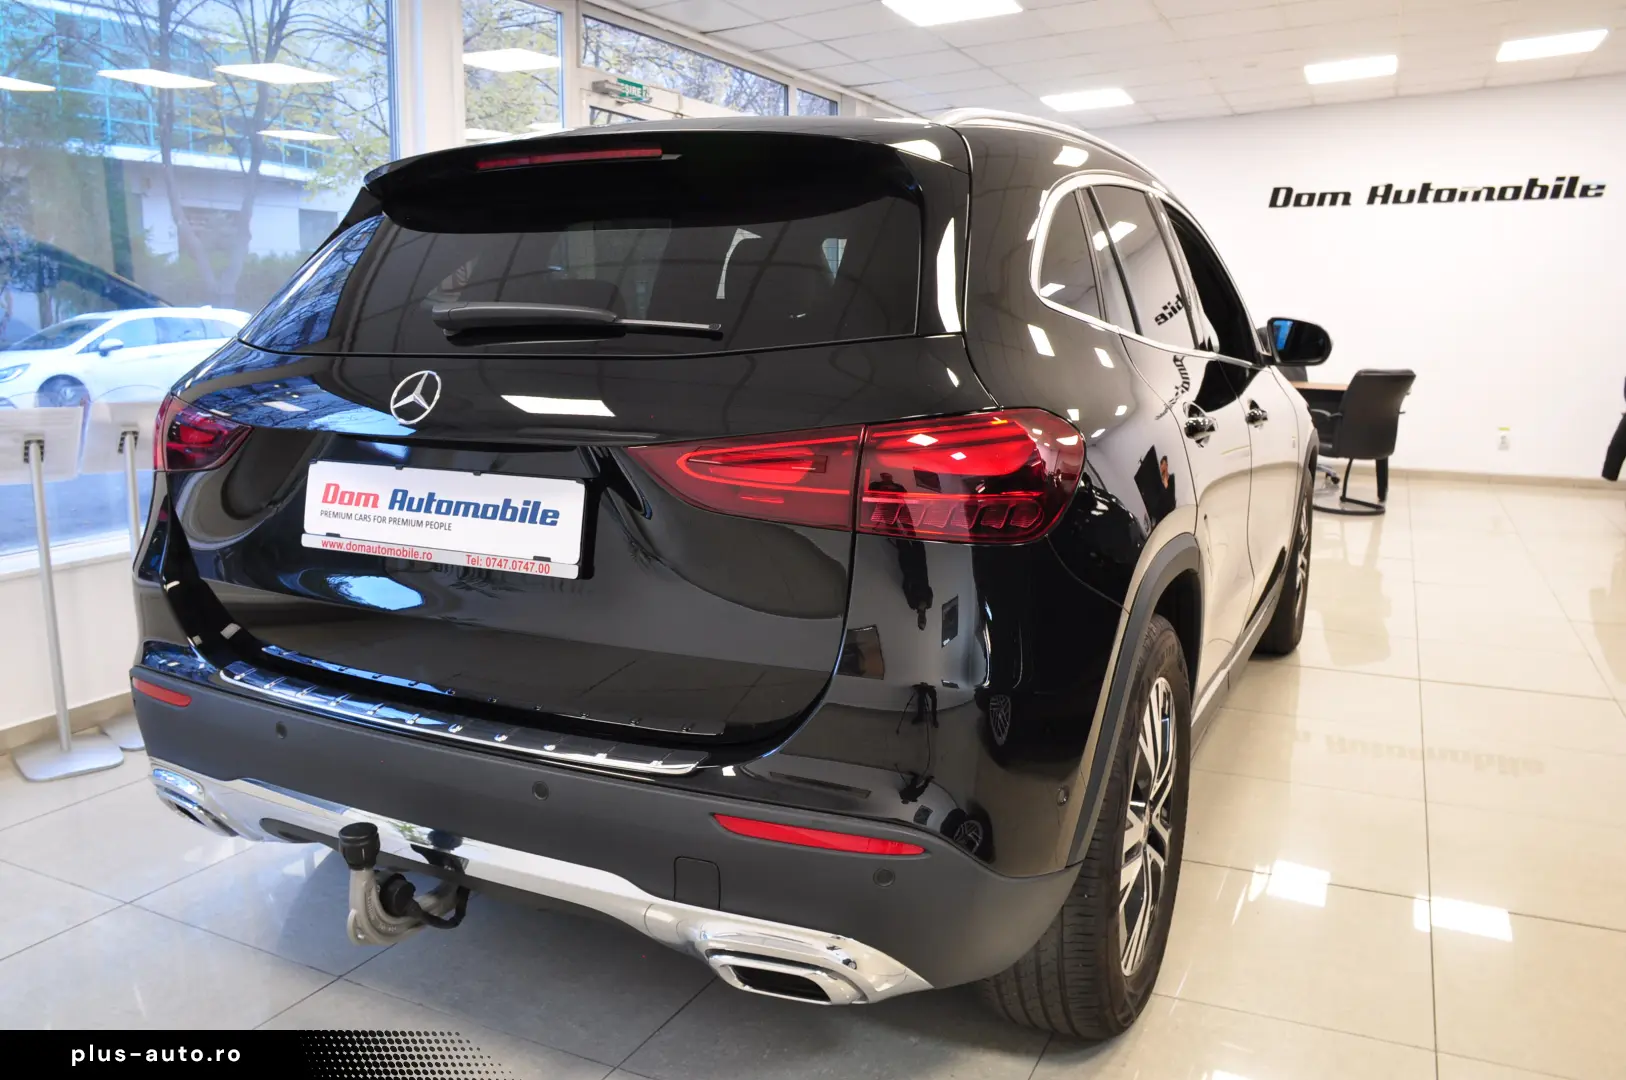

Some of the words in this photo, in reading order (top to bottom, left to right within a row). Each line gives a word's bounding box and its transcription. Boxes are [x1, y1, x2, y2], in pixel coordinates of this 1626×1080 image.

[1268, 186, 1352, 208] Dom
[1366, 176, 1606, 205] Automobile
[320, 509, 353, 521] PREMIUM
[354, 513, 372, 523] CARS
[373, 515, 387, 524] FOR
[388, 517, 424, 528] PREMIUM
[425, 520, 453, 532] PEOPLE
[321, 482, 380, 509] Dom
[388, 488, 560, 527] Automobile
[321, 538, 433, 561] www.domautomobile.ro
[466, 554, 483, 567] Tel:
[485, 556, 551, 575] 0747.0747.00
